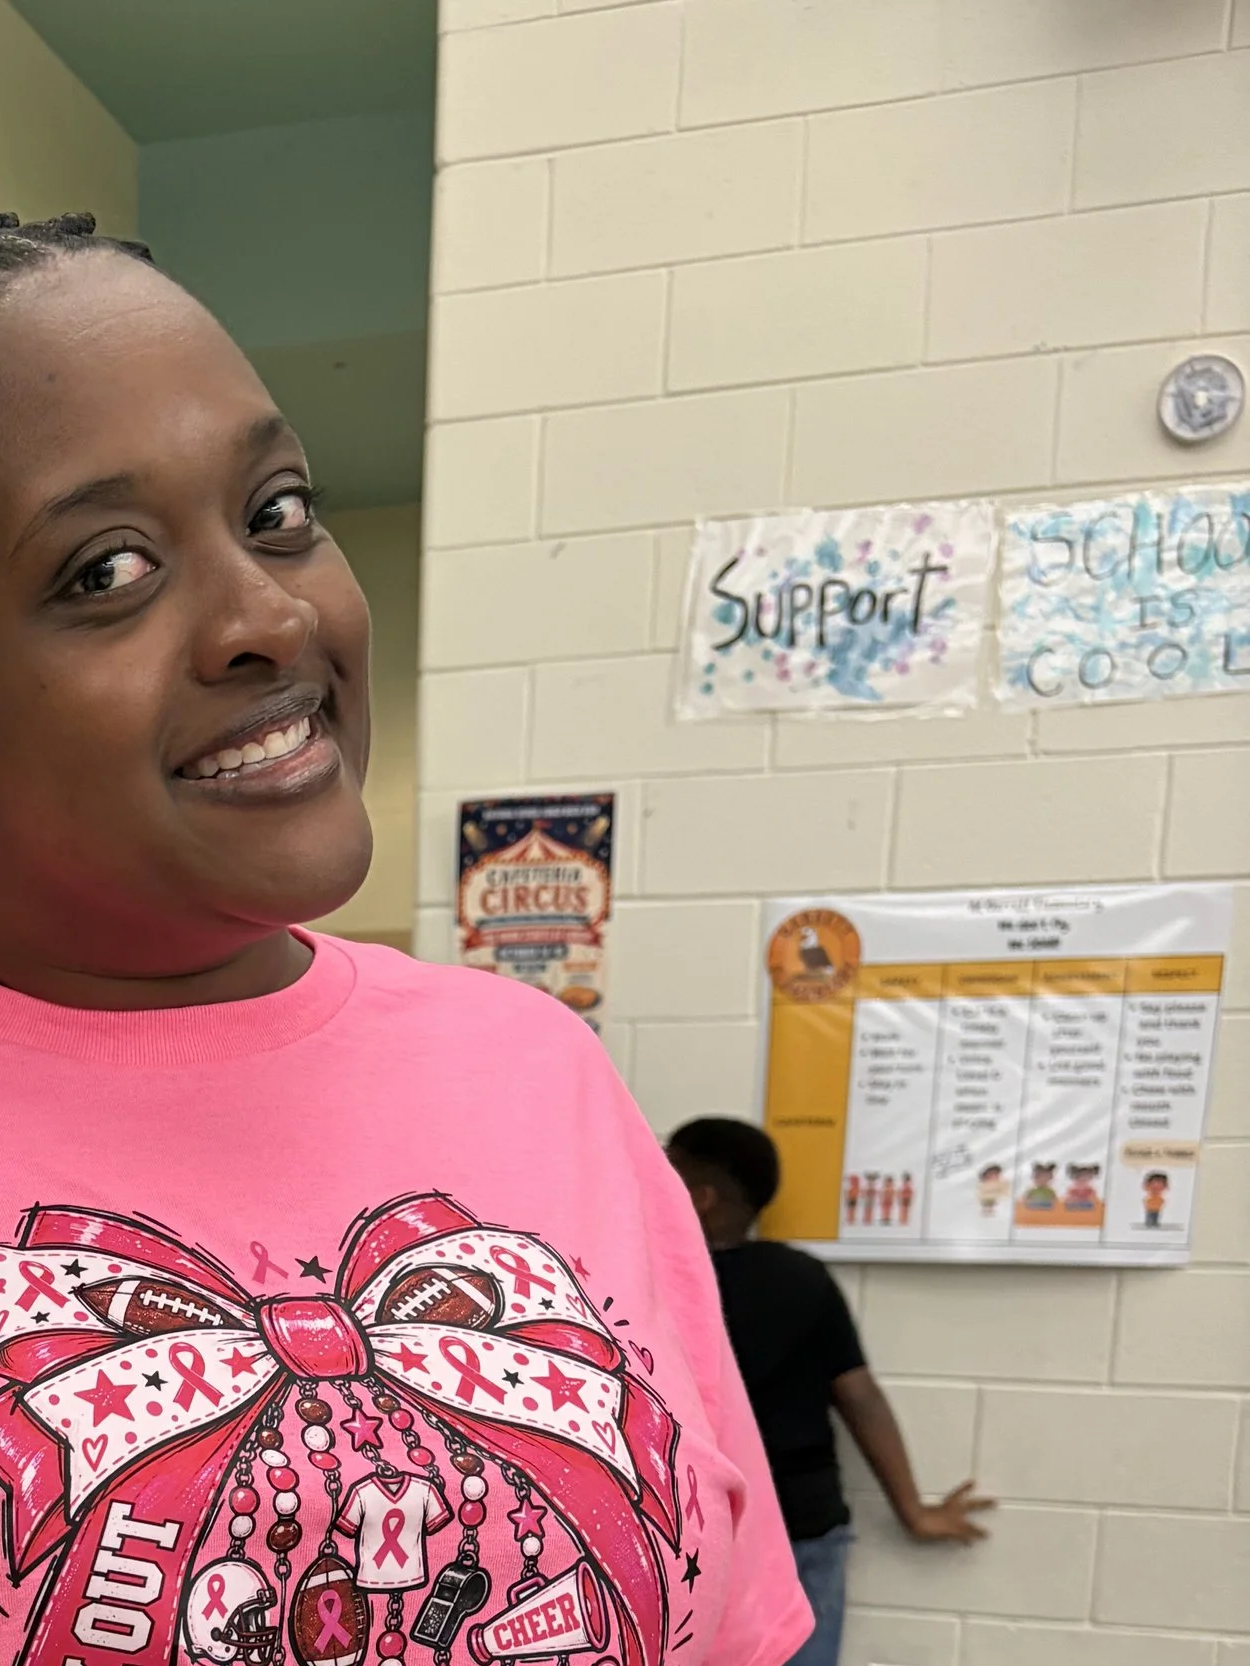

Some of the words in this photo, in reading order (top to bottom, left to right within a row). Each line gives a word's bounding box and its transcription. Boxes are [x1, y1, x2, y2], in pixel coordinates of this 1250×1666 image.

[710, 552, 947, 651] Support
[1131, 588, 1200, 632] IS
[1027, 634, 1250, 697] COOL
[479, 885, 589, 915] CIRCUS
[71, 1498, 184, 1655] OUT
[493, 1592, 581, 1652] CHEER
